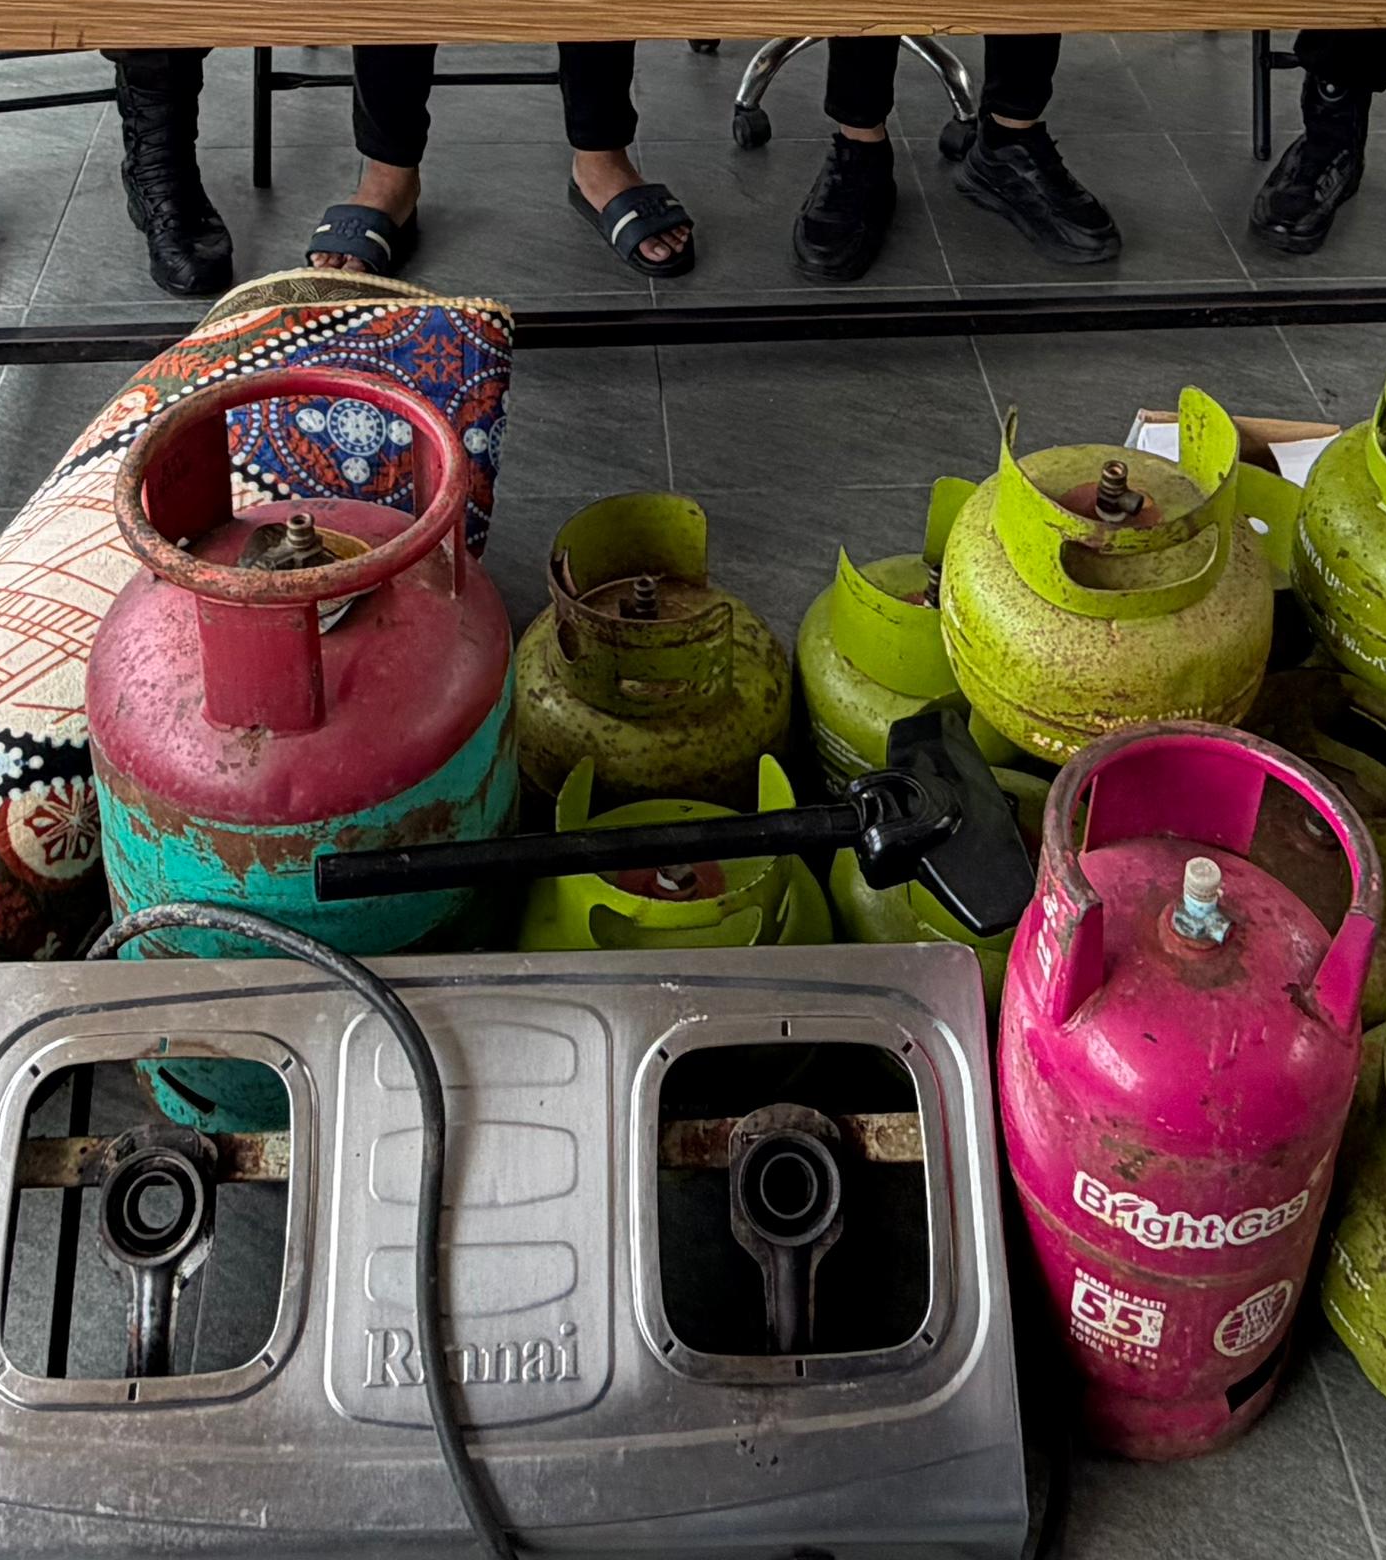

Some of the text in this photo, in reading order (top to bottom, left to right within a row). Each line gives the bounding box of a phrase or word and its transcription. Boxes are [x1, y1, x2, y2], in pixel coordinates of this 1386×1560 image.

[1073, 1171, 1309, 1250] Bright Gas
[363, 1320, 581, 1387] Rnnai
